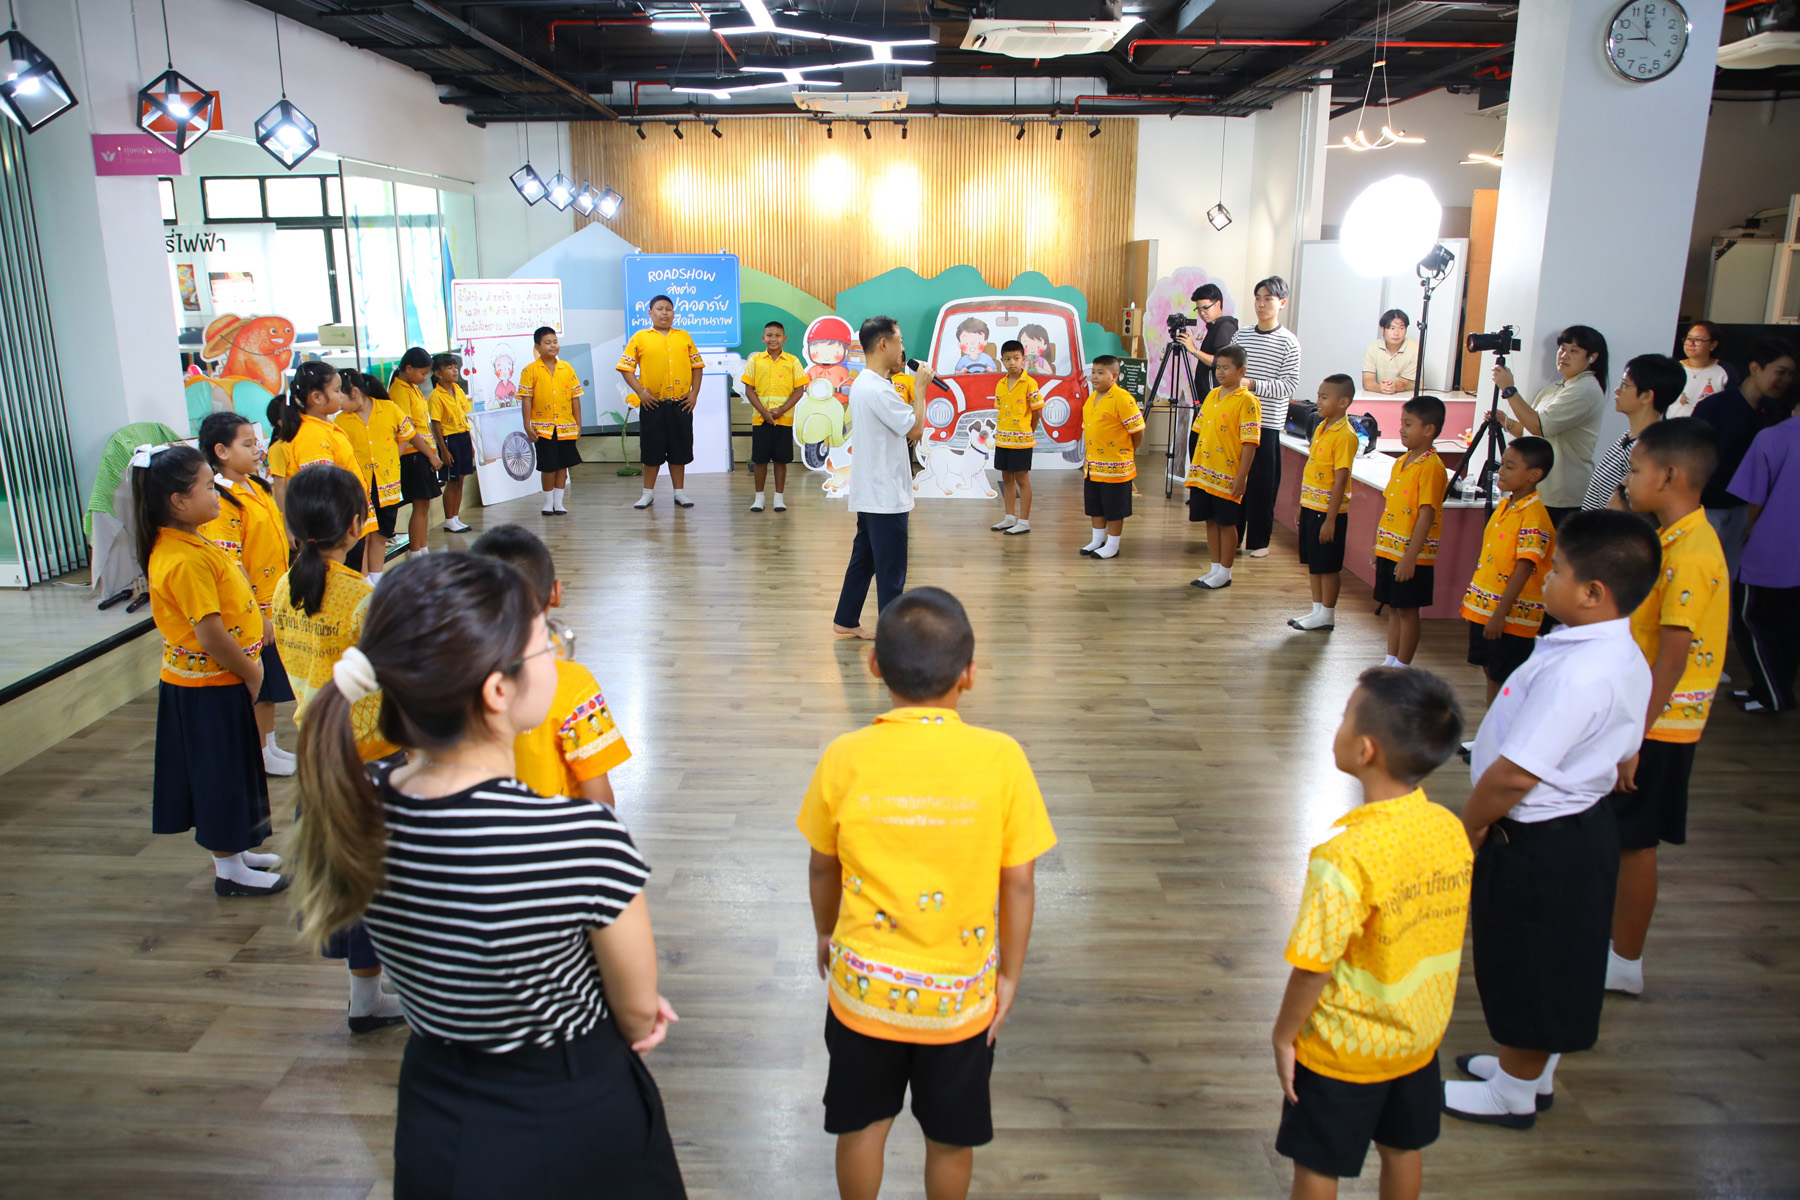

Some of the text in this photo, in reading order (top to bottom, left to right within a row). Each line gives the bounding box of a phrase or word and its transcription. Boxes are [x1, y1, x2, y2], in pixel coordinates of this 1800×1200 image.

[1632, 7, 1640, 17] 11
[1662, 7, 1666, 17] 1
[1620, 19, 1630, 29] 10
[1668, 19, 1676, 29] 2
[1615, 34, 1623, 43] 9
[1670, 35, 1678, 44] 3
[1617, 49, 1625, 58] 8
[1664, 49, 1671, 59] 4
[1628, 60, 1635, 69] 7
[1638, 64, 1646, 73] 6
[1652, 60, 1660, 70] 5
[648, 268, 716, 283] ROADSHOW
[666, 282, 697, 295] ส่งต่อ
